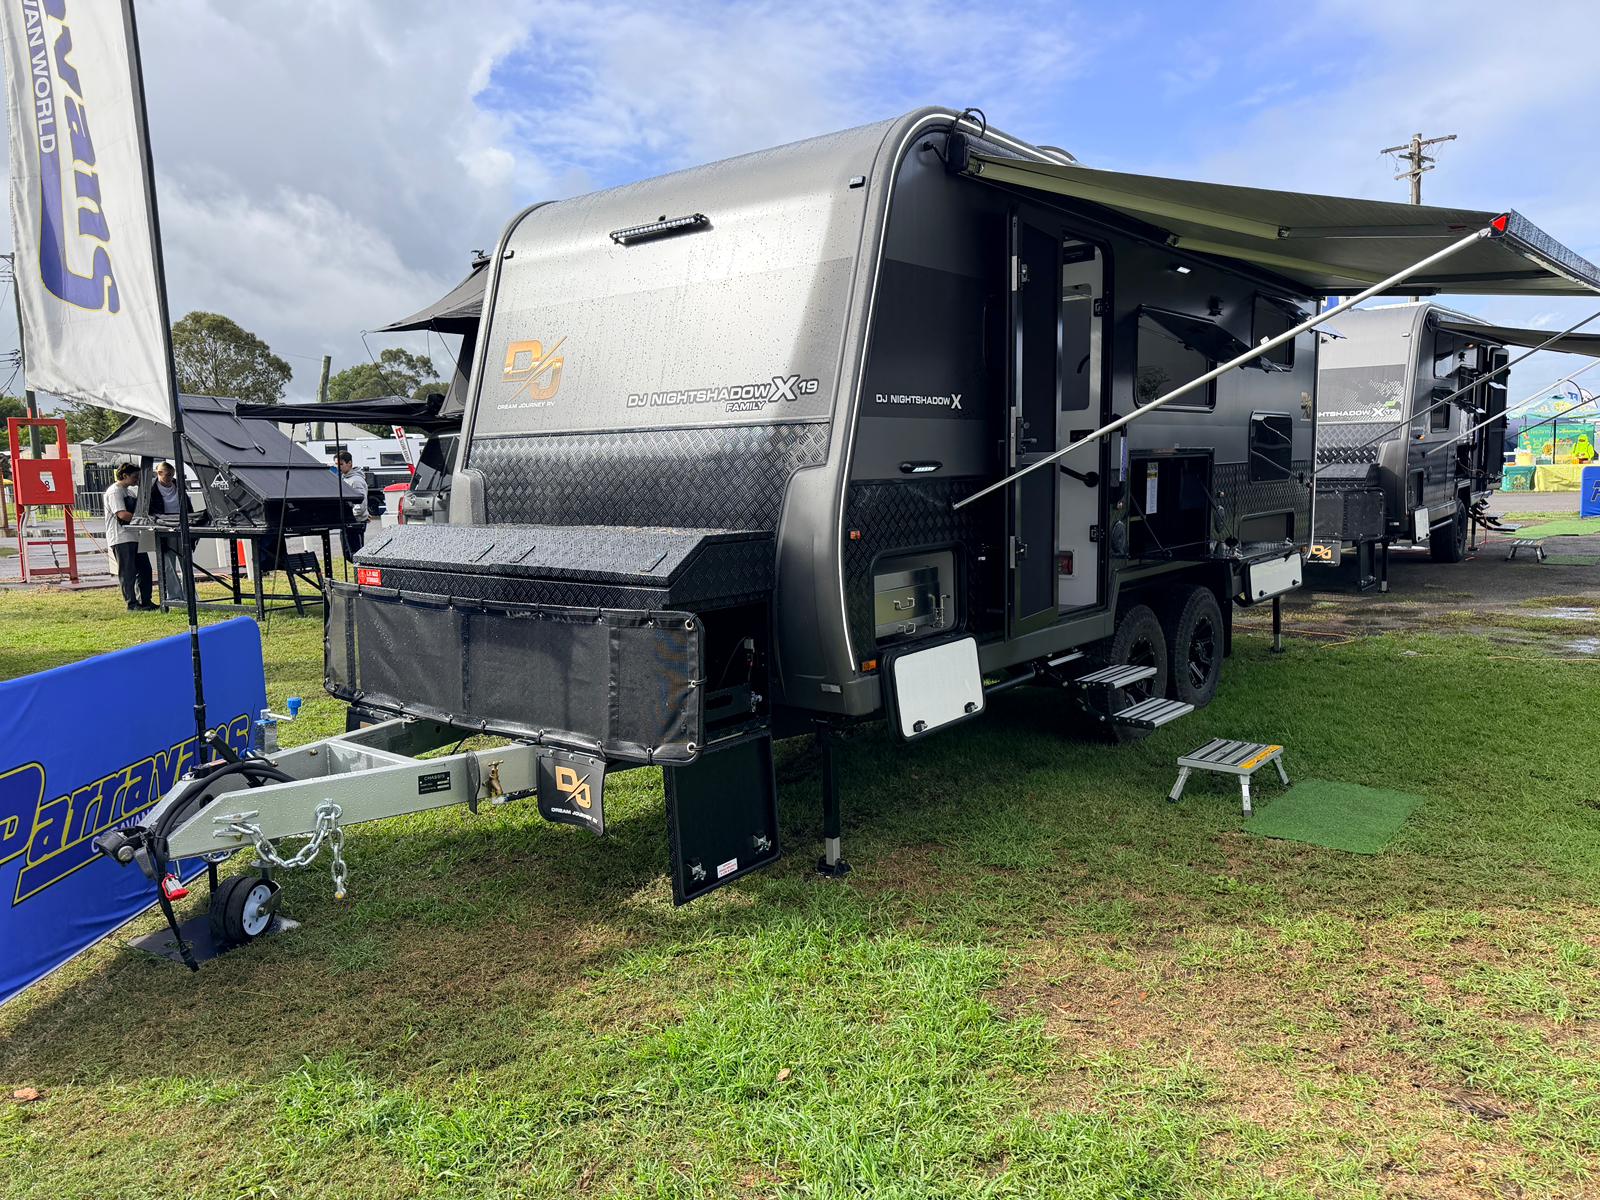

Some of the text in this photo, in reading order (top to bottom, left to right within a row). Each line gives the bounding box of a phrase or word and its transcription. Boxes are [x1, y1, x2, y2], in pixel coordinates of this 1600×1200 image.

[31, 49, 56, 154] WORLD
[626, 393, 649, 408] DJ
[875, 393, 888, 403] DJ
[725, 400, 767, 413] FAMILY
